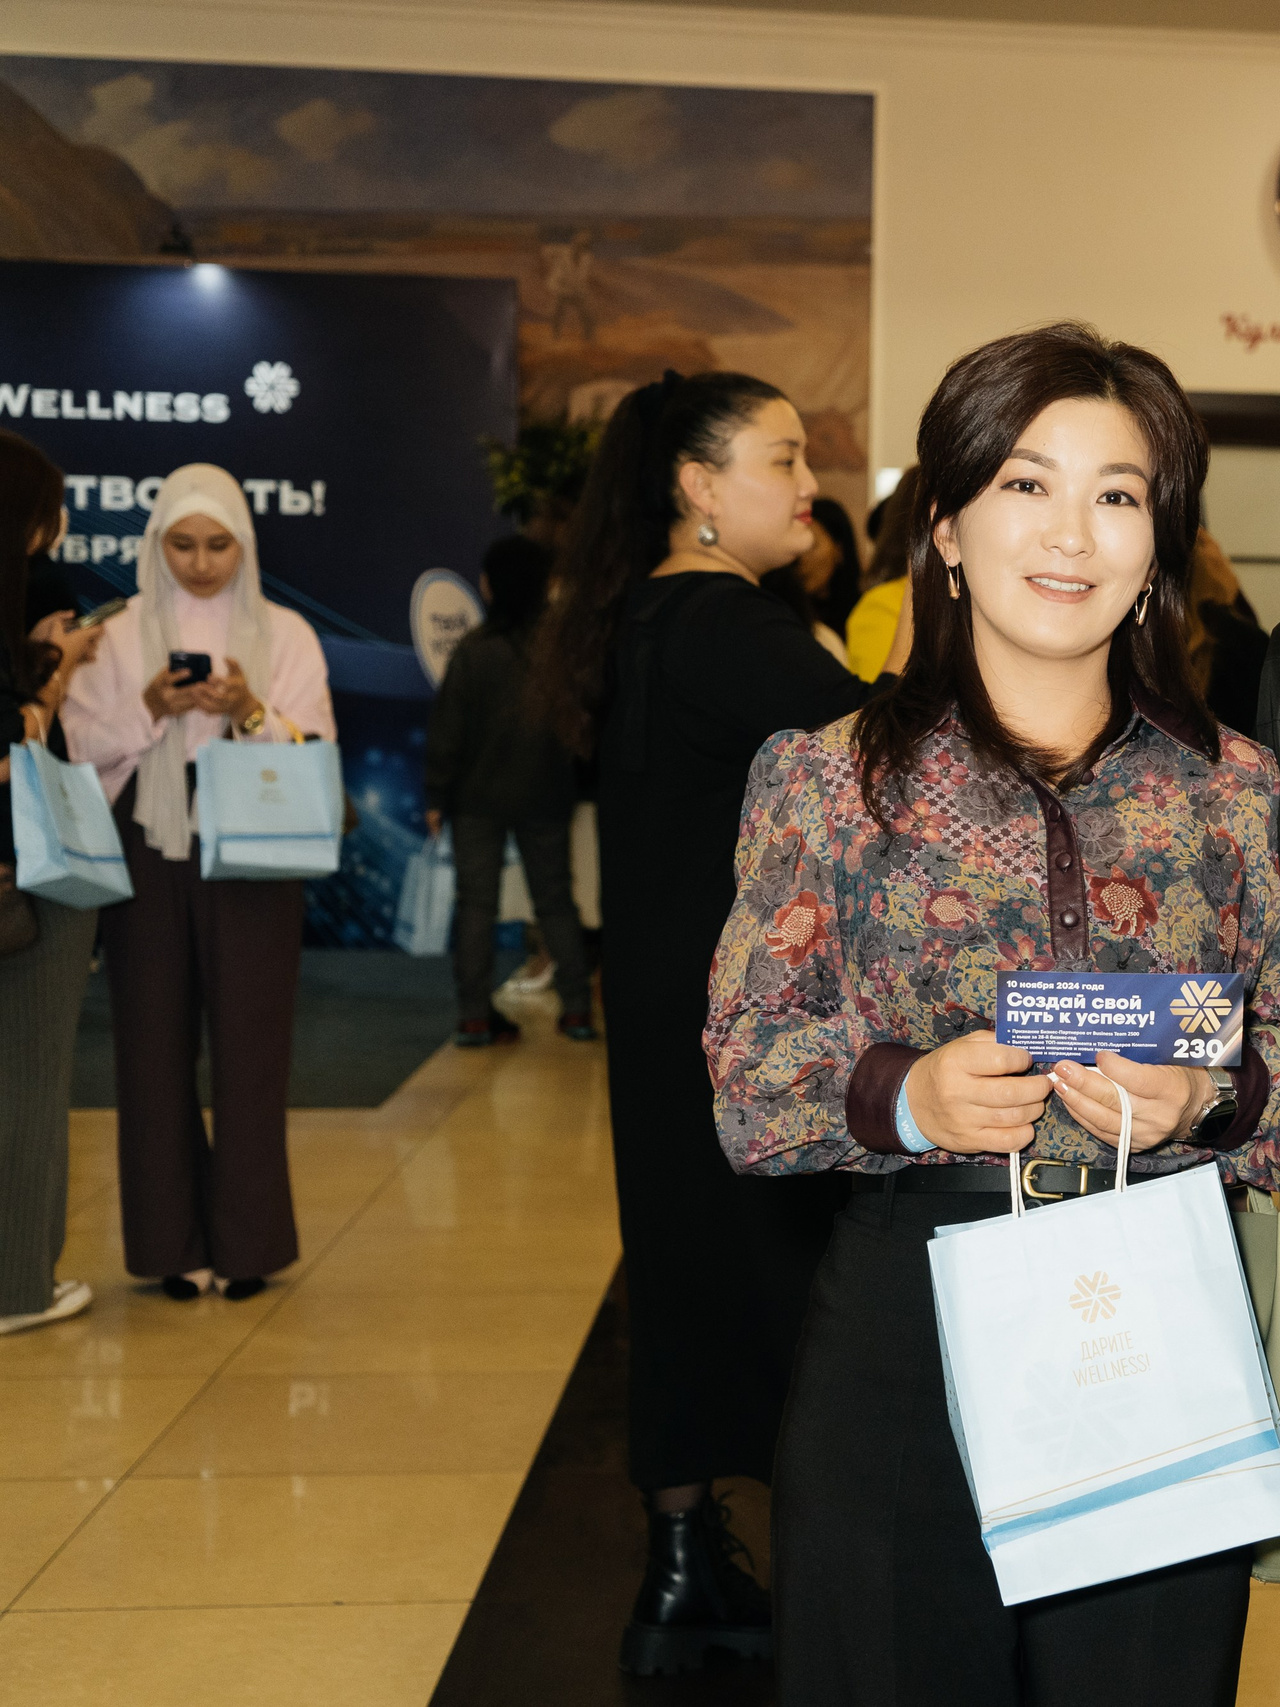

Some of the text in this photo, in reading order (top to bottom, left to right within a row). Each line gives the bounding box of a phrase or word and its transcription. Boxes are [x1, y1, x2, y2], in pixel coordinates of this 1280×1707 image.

[64, 474, 327, 517] ТВОТЬ!
[1020, 981, 1054, 990] ноября
[1006, 992, 1142, 1010] Создай свой
[1006, 1010, 1155, 1028] путь к успеху!
[1173, 1038, 1224, 1059] 230
[1080, 1330, 1134, 1362] ДАРИТЕ
[1072, 1352, 1151, 1388] WELLNESS!
